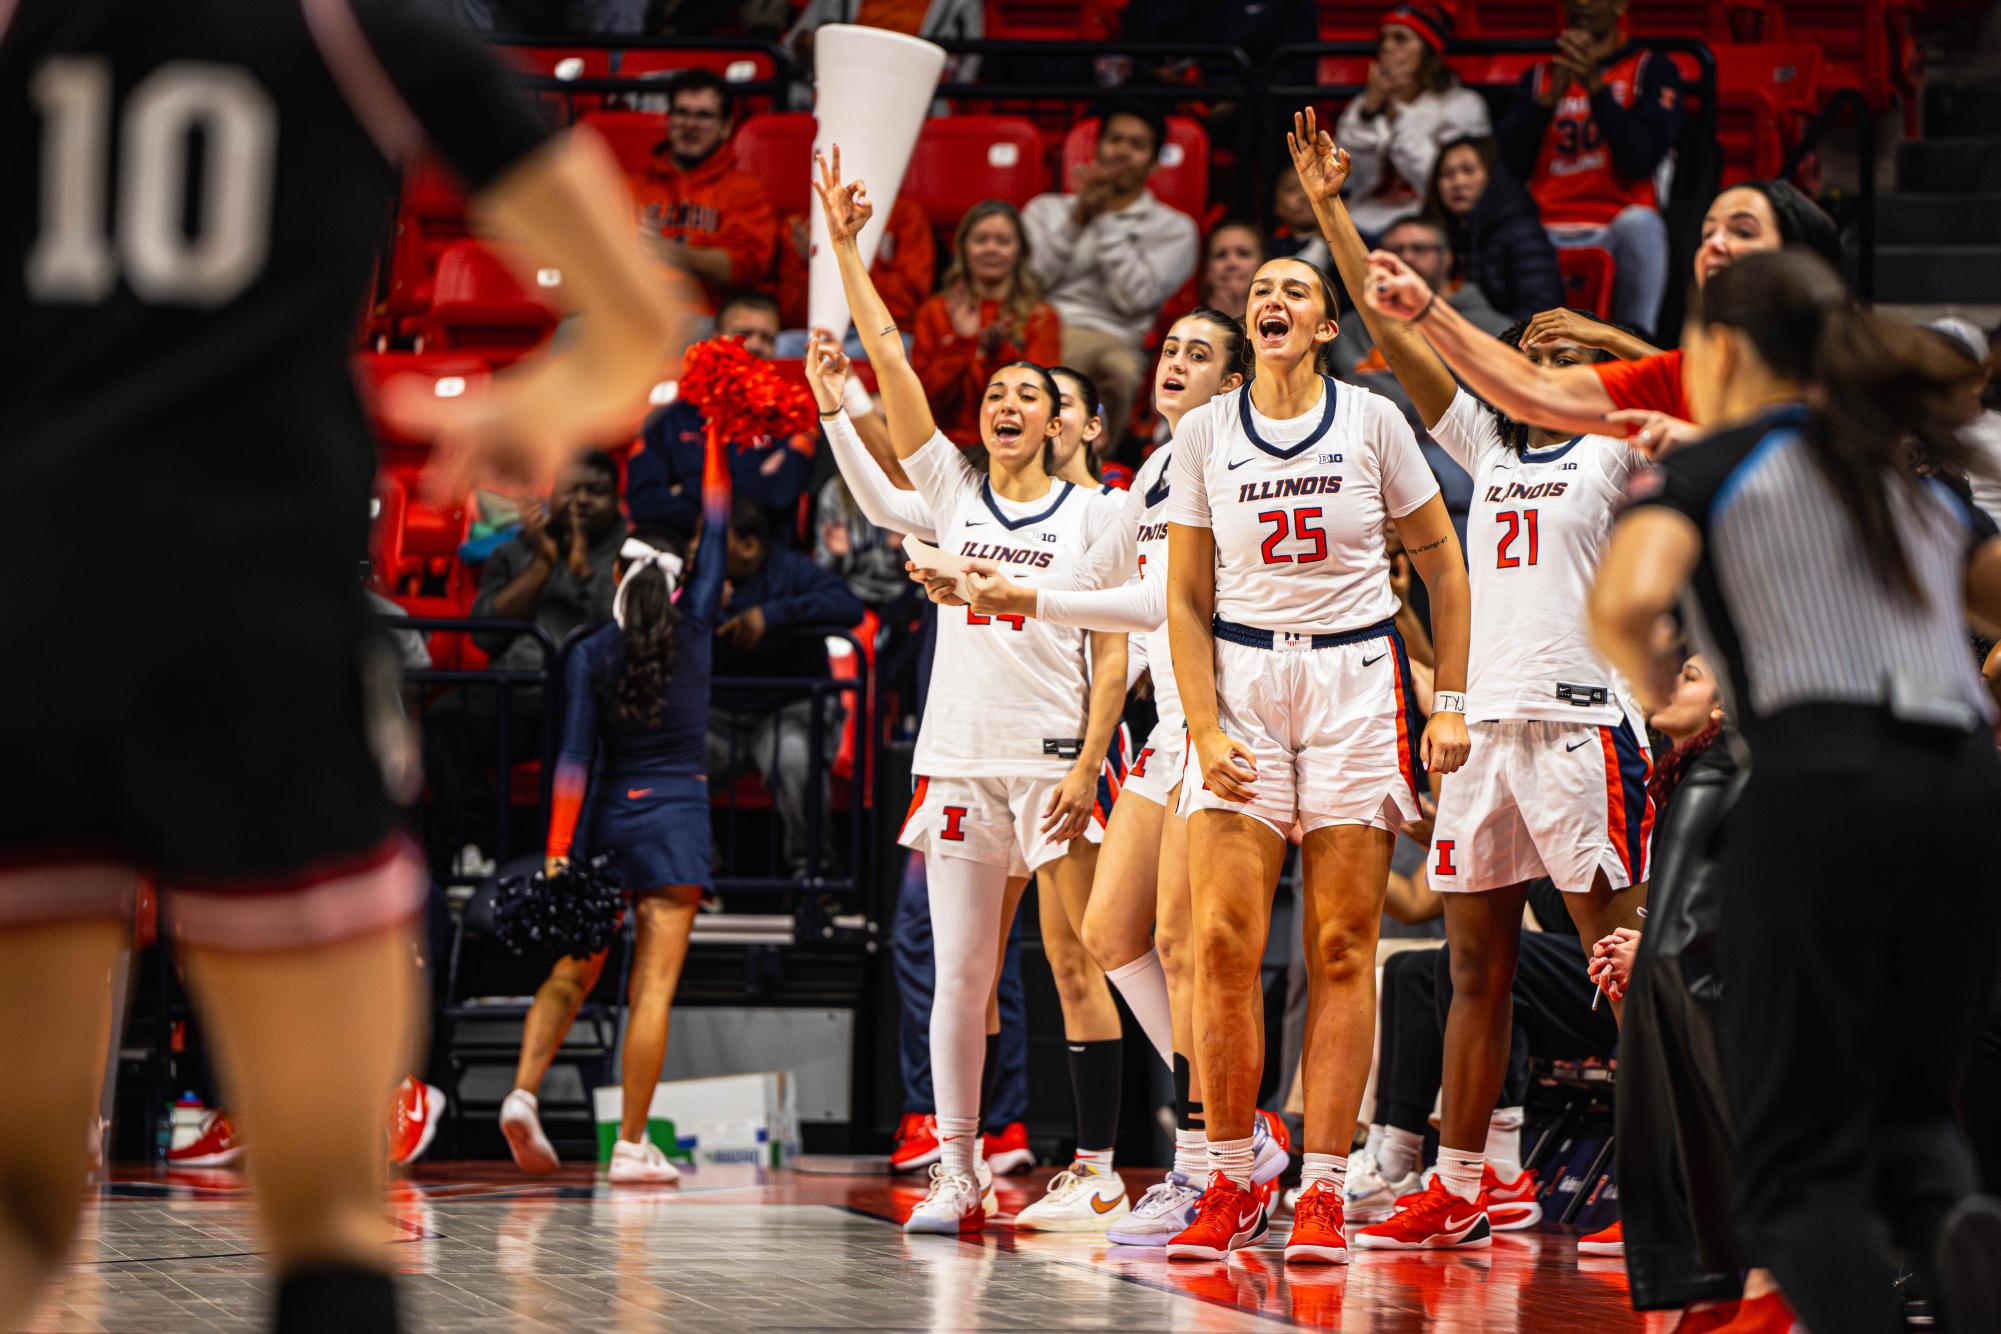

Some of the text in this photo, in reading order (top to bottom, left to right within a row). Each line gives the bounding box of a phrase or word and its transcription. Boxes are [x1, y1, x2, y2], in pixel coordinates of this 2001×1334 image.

[26, 54, 277, 308] 10
[1239, 475, 1343, 504] ILLINOIS
[1484, 481, 1569, 503] ILINOIS
[1258, 507, 1328, 565] 25
[1496, 509, 1538, 569] 21
[960, 541, 1054, 569] ILLINOIS
[940, 806, 968, 841] I
[1435, 839, 1456, 876] I
